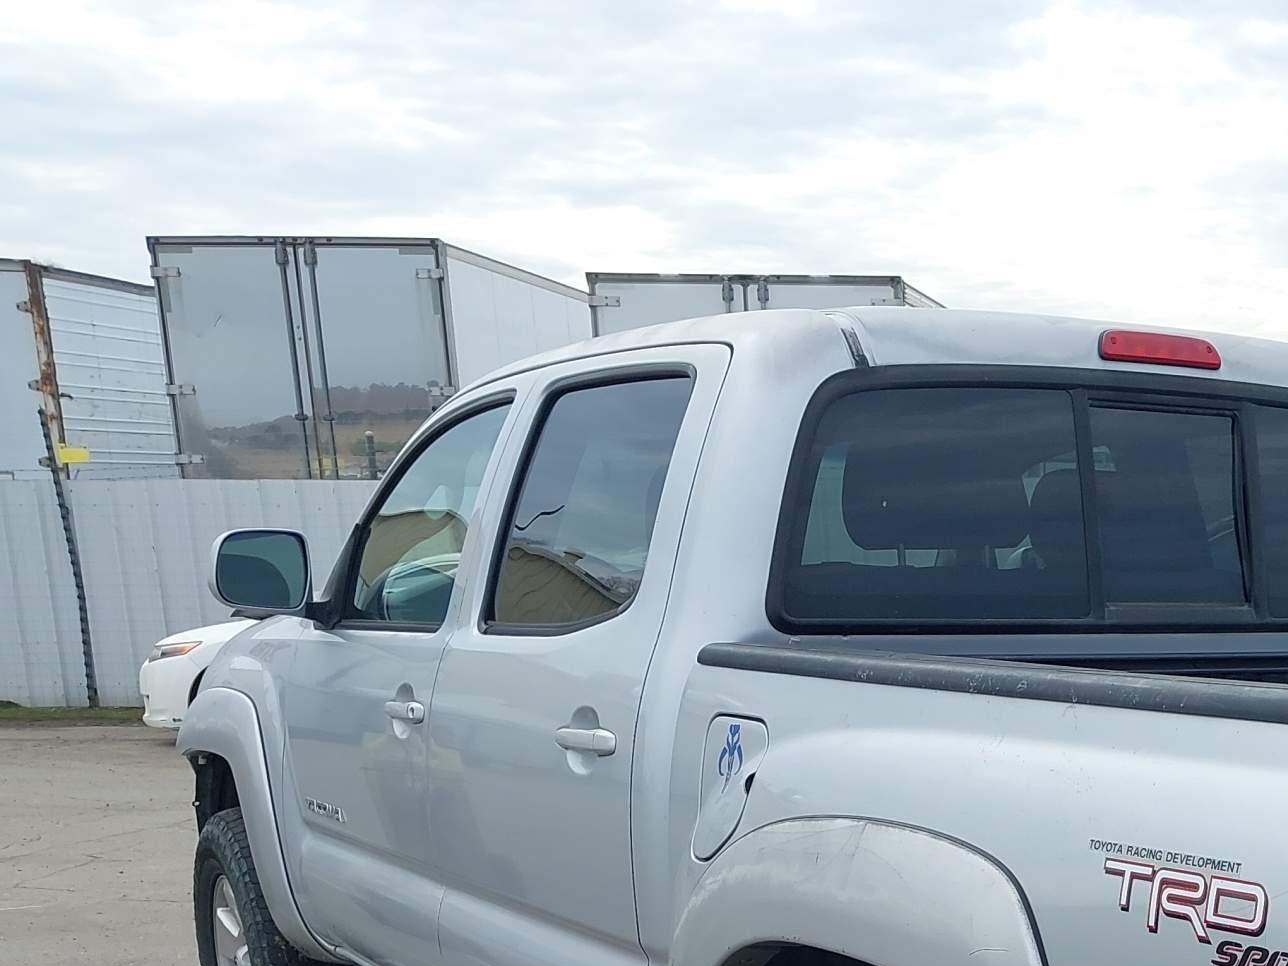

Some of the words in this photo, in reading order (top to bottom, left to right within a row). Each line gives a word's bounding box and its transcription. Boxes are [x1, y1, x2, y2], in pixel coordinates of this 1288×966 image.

[1089, 839, 1123, 855] TOYOTA
[1126, 845, 1163, 862] RACING
[1165, 851, 1243, 874] DEVELOPMENT
[1104, 857, 1269, 945] TRD
